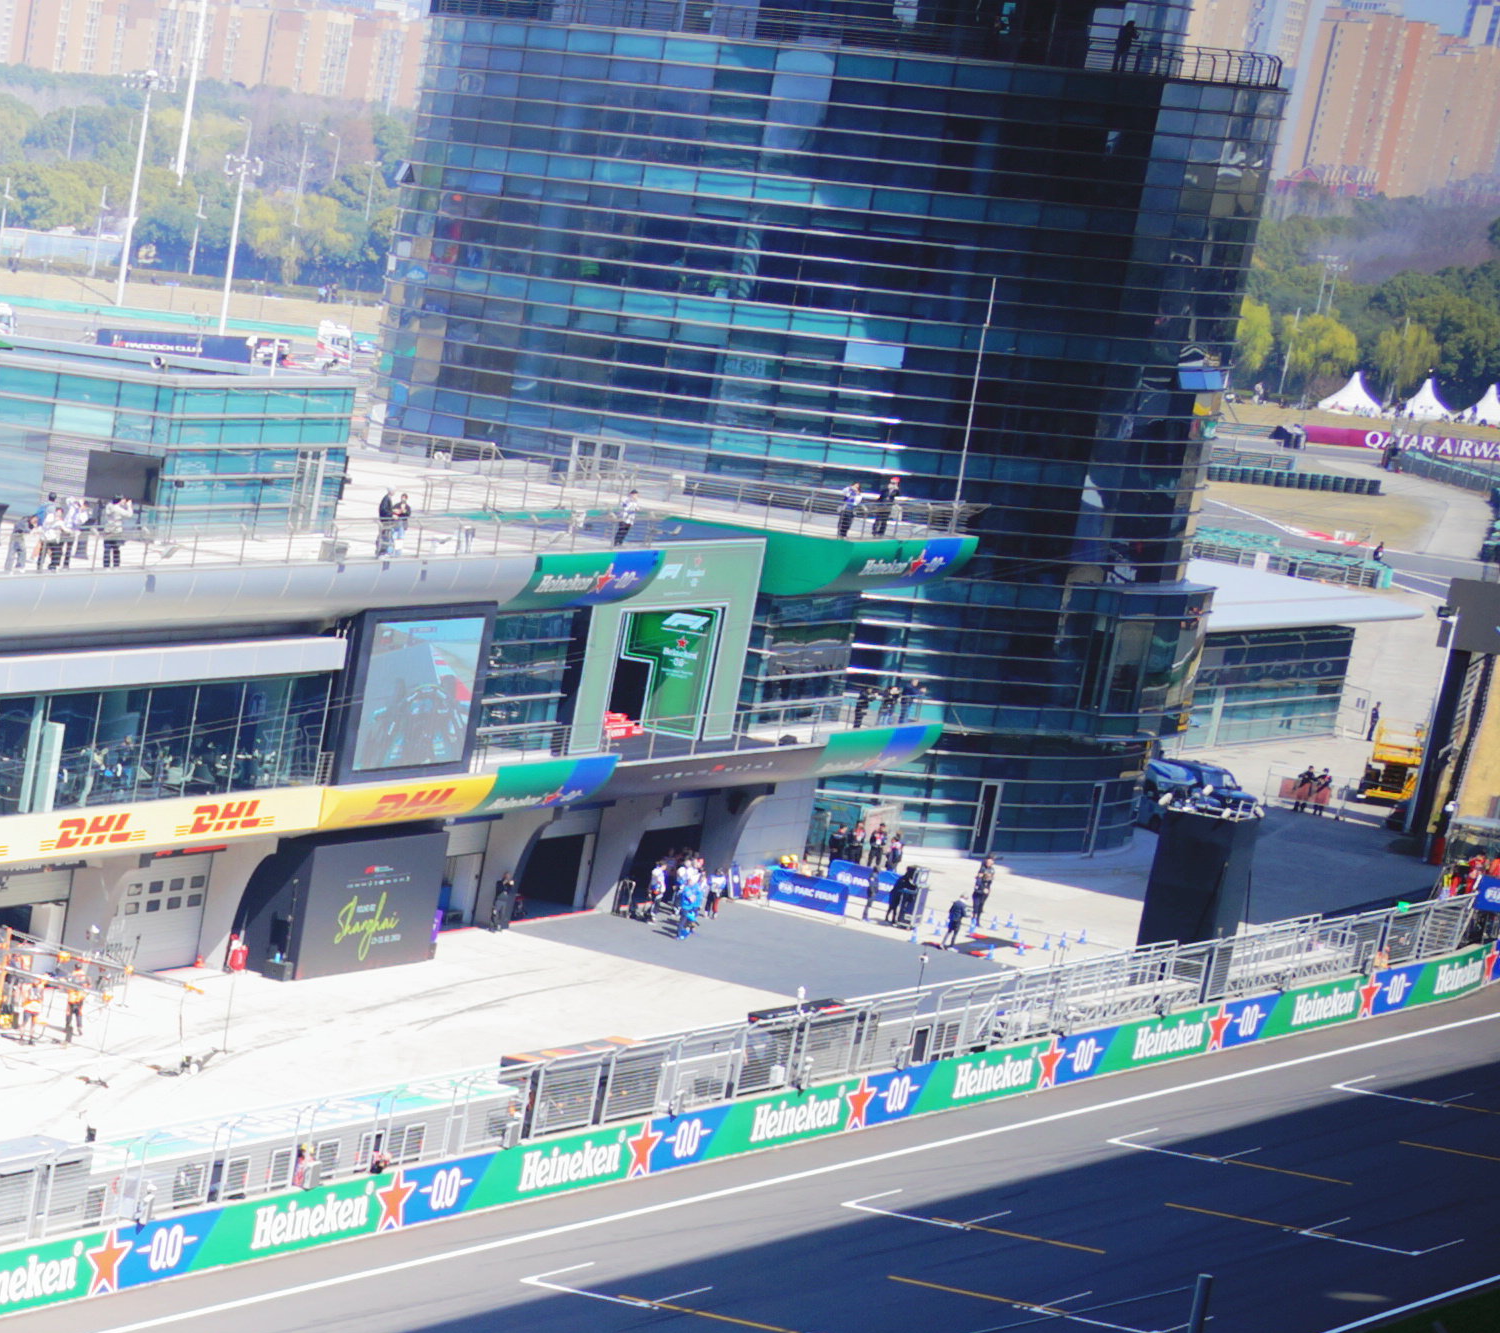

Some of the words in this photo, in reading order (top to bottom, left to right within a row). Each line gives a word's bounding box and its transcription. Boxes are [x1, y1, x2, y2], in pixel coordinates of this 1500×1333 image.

[534, 574, 594, 593] Heineken
[859, 560, 908, 576] Heineken
[187, 801, 261, 835] DHL
[362, 788, 456, 821] DHL
[55, 813, 132, 849] DHL
[794, 884, 814, 898] PARC
[334, 881, 399, 952] Shanghai
[1434, 958, 1481, 994] Heineken
[1291, 990, 1355, 1026] Heineken
[1132, 1019, 1202, 1060] Heineken
[952, 1055, 1033, 1099] Heineken
[750, 1094, 840, 1142] Heineken
[519, 1139, 620, 1192] Heineken
[250, 1193, 369, 1250] Heineken
